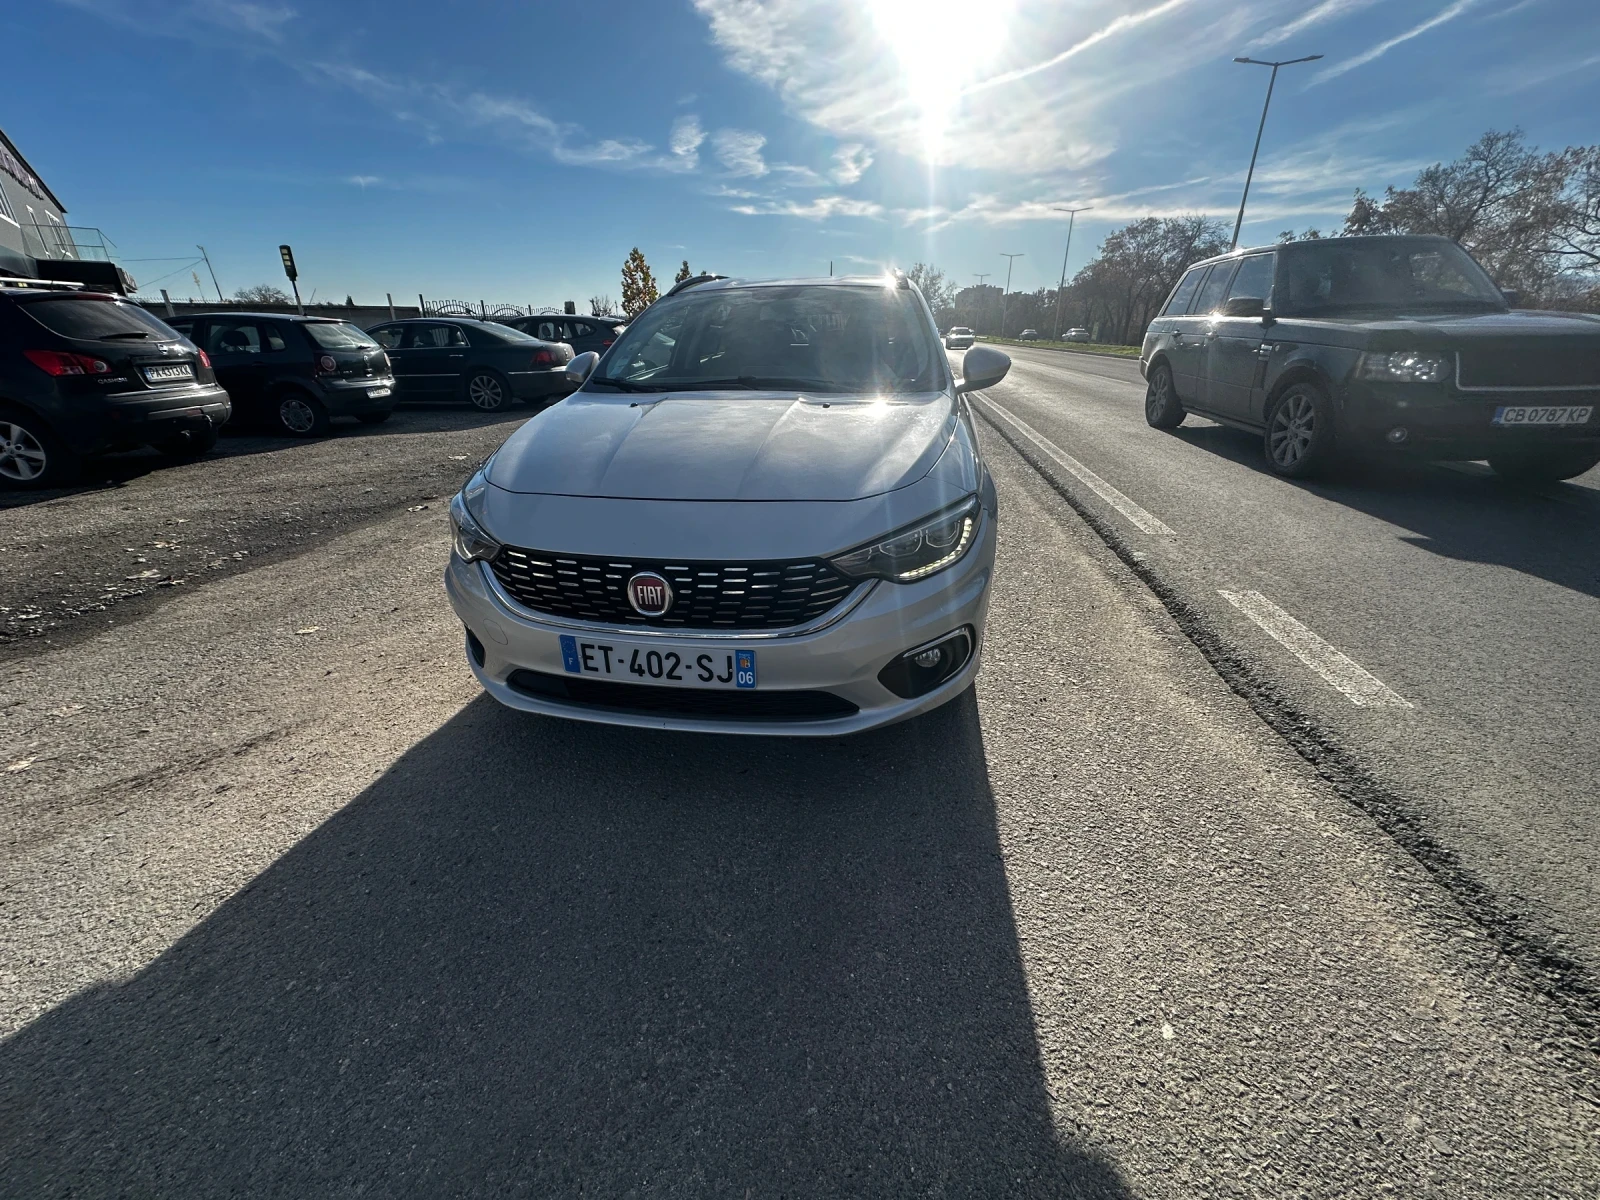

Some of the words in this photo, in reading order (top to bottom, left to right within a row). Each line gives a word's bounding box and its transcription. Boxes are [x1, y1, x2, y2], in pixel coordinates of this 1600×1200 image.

[1503, 408, 1526, 422] CB
[1528, 408, 1567, 422] 0787
[1567, 407, 1588, 422] KP
[637, 585, 662, 605] FIAT
[568, 657, 574, 666] F
[580, 643, 733, 683] ET-402-SJ
[738, 671, 754, 684] 06
